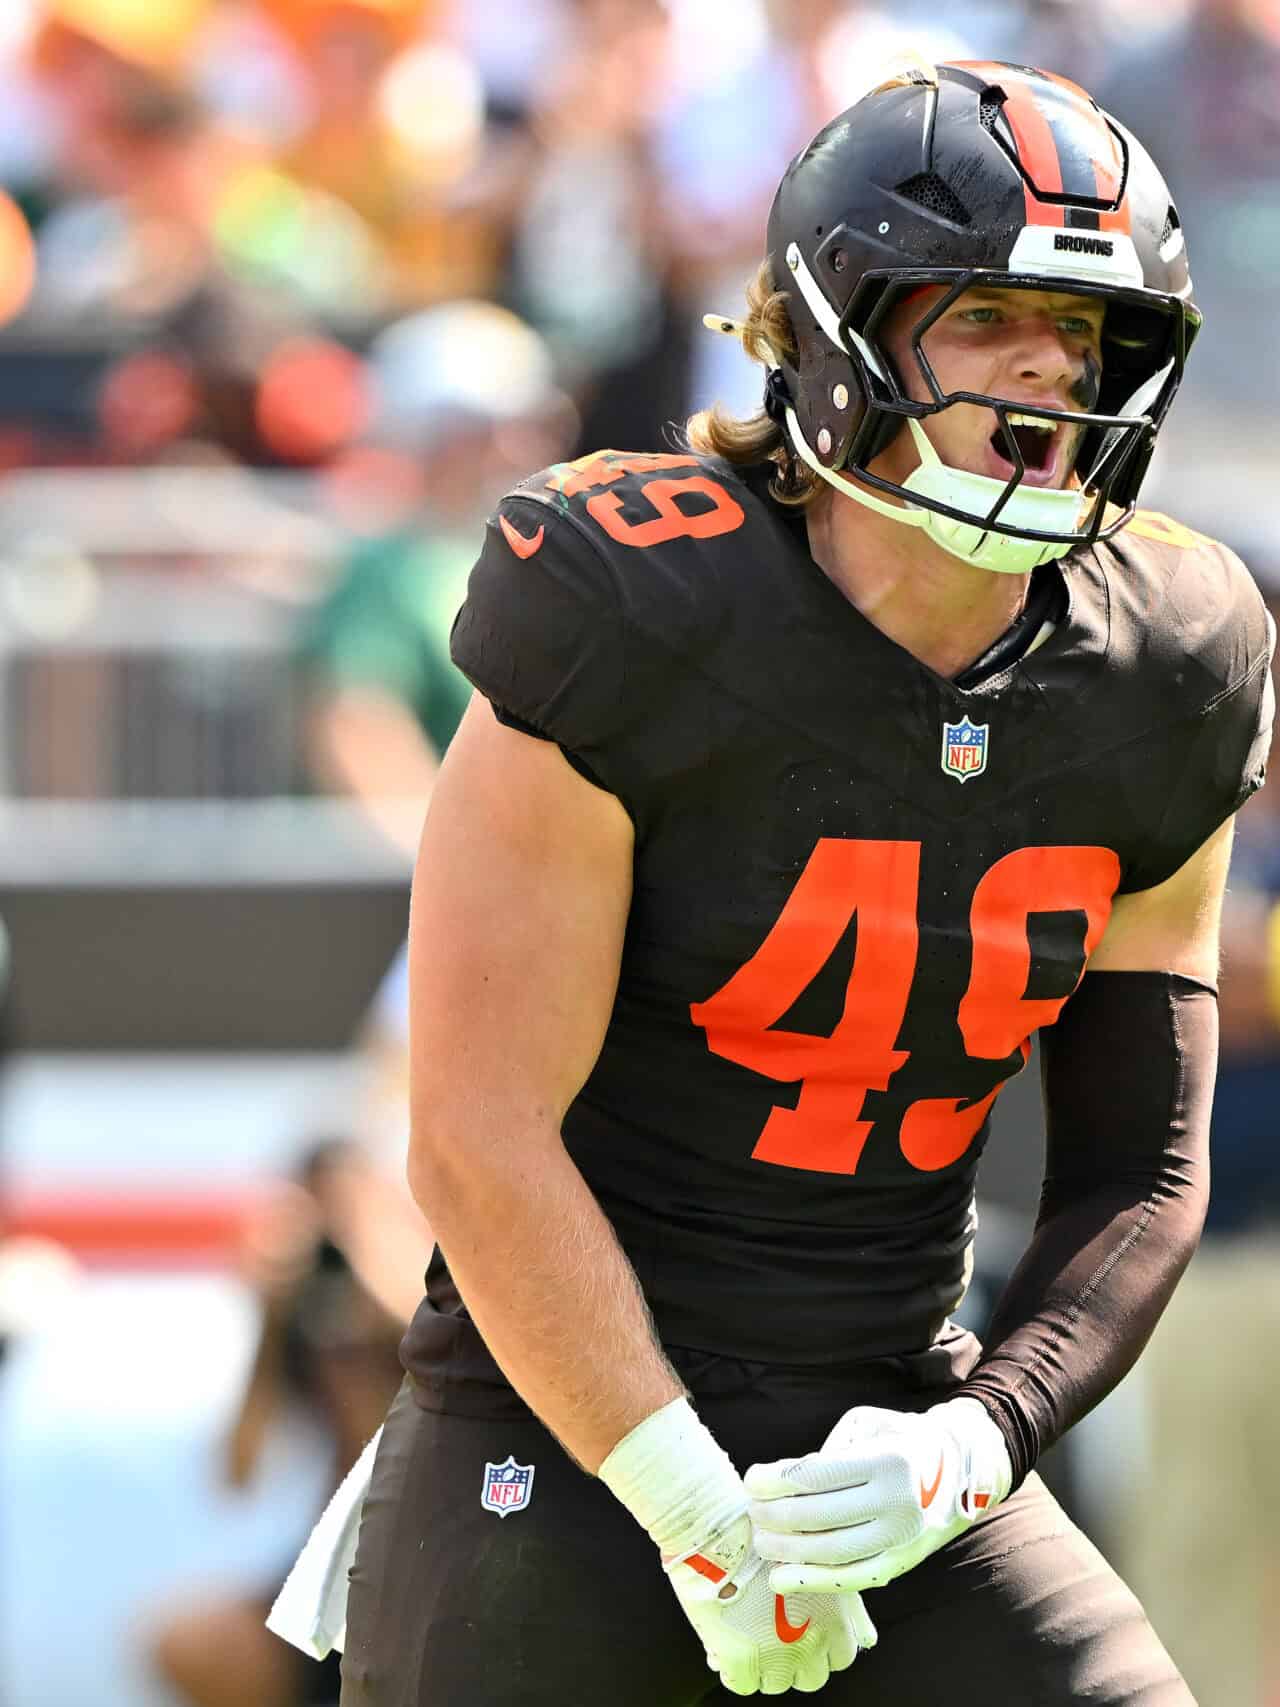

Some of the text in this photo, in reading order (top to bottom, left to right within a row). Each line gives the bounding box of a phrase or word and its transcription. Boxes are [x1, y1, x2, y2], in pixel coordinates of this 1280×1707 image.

[1054, 234, 1113, 256] BROWNS
[545, 449, 744, 548] 49
[949, 746, 980, 770] NFL
[690, 838, 1120, 1175] 49
[490, 1484, 522, 1504] NFL
